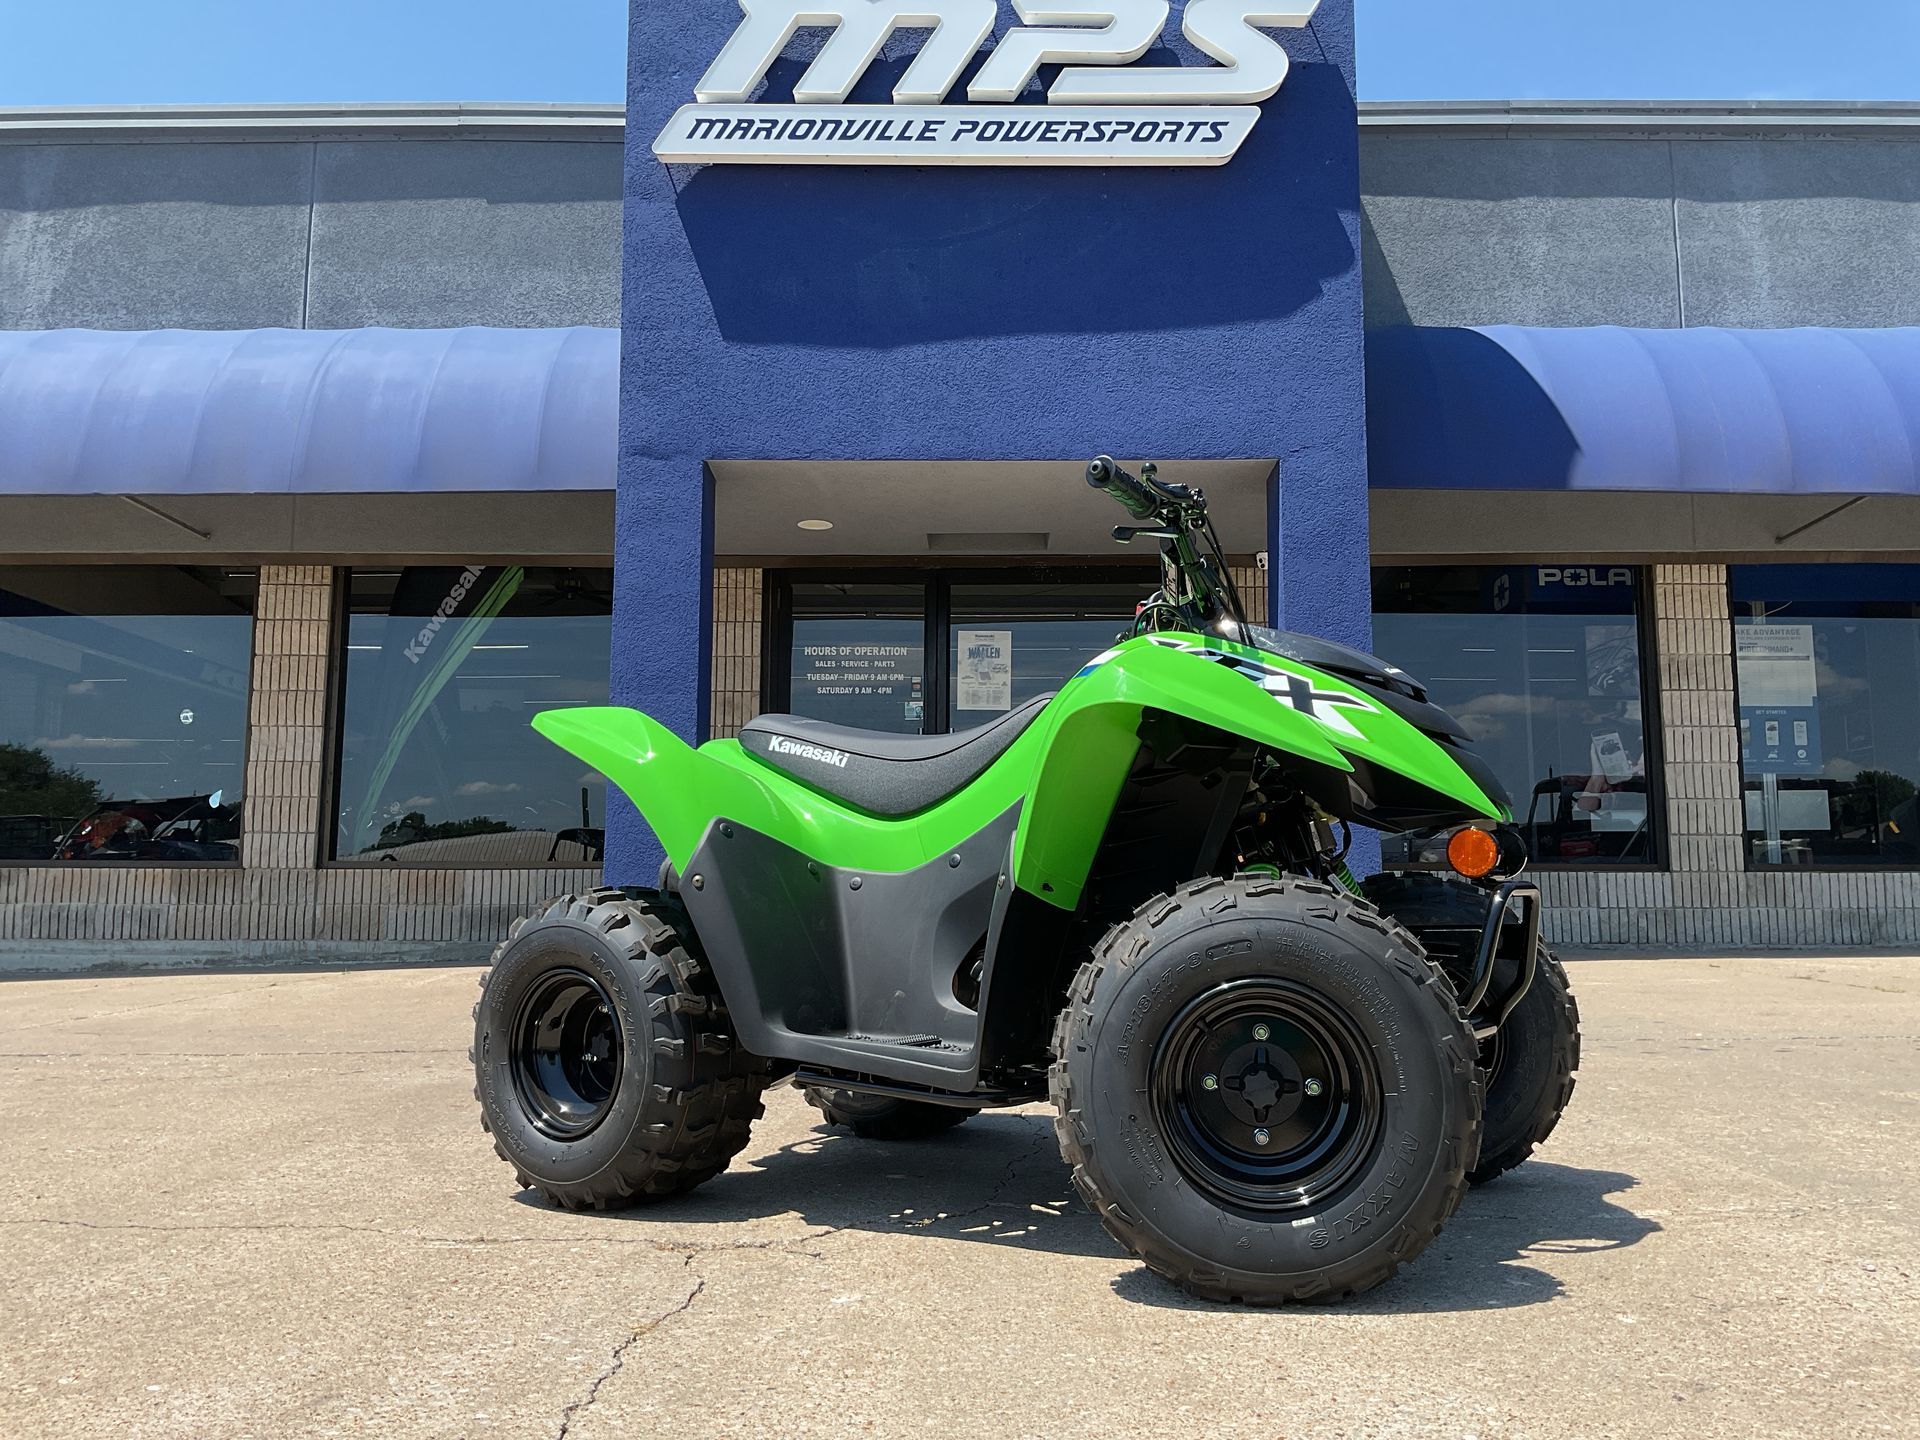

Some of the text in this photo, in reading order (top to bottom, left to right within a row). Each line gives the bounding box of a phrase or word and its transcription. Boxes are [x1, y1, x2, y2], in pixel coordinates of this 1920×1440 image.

[694, 0, 1321, 104] MPS
[686, 118, 1231, 143] MARIONVILLE POWERSPORTS
[1538, 568, 1634, 586] POLA
[1753, 628, 1801, 636] ADVANTAGE
[804, 646, 907, 656] HOURS OF OPERATION
[815, 660, 836, 668] SALES
[841, 660, 869, 668] SERVICE
[874, 660, 895, 668] PARTS
[807, 673, 839, 681] TUESDAY
[844, 673, 868, 681] FRIDAY
[870, 673, 875, 681] 9
[817, 686, 855, 694] SATURDAY
[855, 686, 860, 694] 9
[861, 686, 872, 694] AM
[877, 686, 893, 694] 4PM
[768, 735, 850, 768] Kawasaki
[1276, 936, 1293, 946] SEE
[1308, 1131, 1421, 1249] MAXXIS
